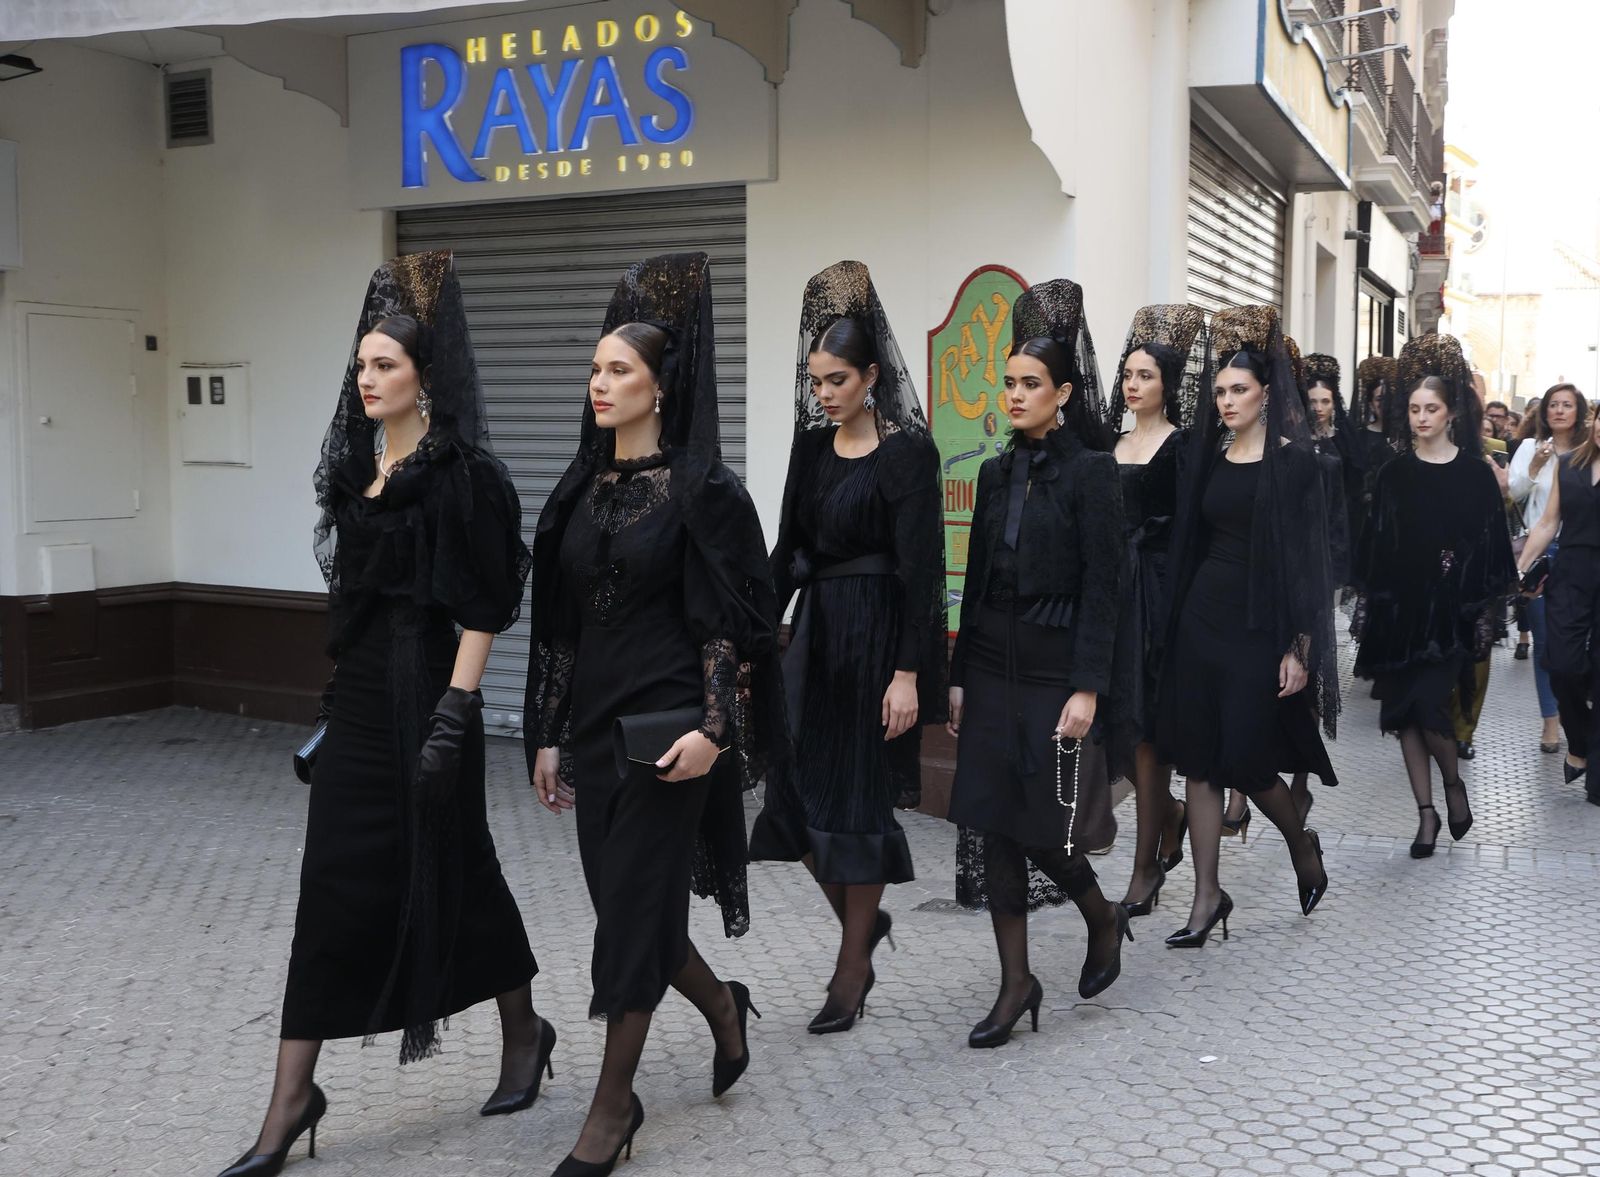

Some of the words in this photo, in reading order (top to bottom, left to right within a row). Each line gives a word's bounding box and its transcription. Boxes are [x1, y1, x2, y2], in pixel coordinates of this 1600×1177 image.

[466, 10, 693, 63] HELADOS
[401, 44, 693, 188] RAYAS
[495, 158, 592, 182] DESDE
[617, 150, 694, 173] 1980
[937, 292, 1013, 420] RAY
